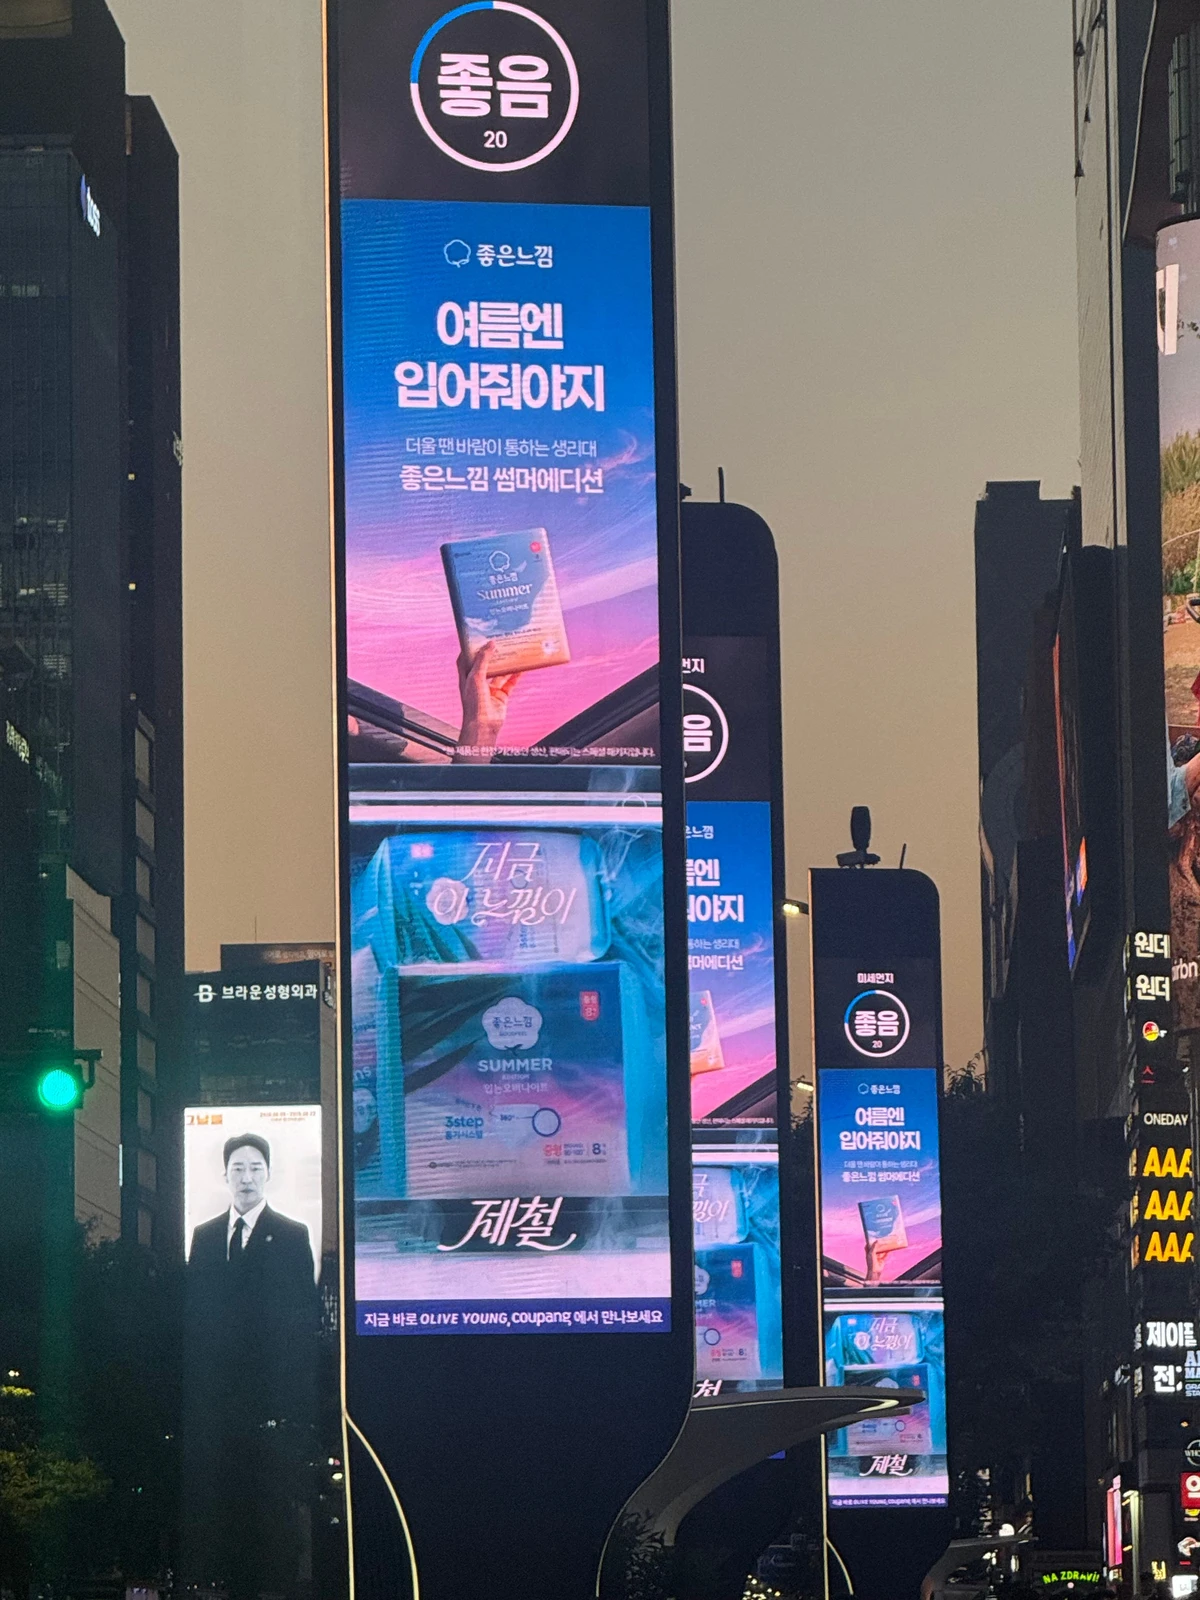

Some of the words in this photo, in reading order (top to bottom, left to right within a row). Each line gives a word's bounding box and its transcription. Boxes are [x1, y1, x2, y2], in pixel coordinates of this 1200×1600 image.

[437, 52, 553, 119] 좋음
[483, 130, 508, 149] 20
[475, 243, 554, 268] 좋은느낌
[436, 300, 565, 350] 여름엔
[393, 361, 606, 412] 입어줘야지
[405, 437, 437, 456] 더울
[438, 437, 455, 457] 땐
[456, 438, 502, 457] 바람이
[504, 439, 549, 457] 통하는
[551, 440, 597, 458] 생리대
[399, 464, 489, 493] 좋은느낌
[492, 466, 605, 494] 썸머에디션
[221, 983, 318, 1001] 브라운성형외과
[854, 1010, 900, 1037] 좋음
[872, 1040, 883, 1048] 20
[477, 1057, 553, 1073] SUMMER
[444, 1115, 484, 1128] 3step
[855, 1107, 905, 1127] 여름엔
[1143, 1112, 1189, 1126] ONEDAY
[839, 1131, 922, 1151] 입어줘야지
[437, 1196, 577, 1252] 제철
[364, 1312, 390, 1327] 지금
[392, 1311, 418, 1327] 바로
[420, 1312, 458, 1326] OLIVE
[573, 1310, 599, 1325] 에서
[601, 1309, 664, 1325] 만나보세요
[1042, 1572, 1059, 1584] NA
